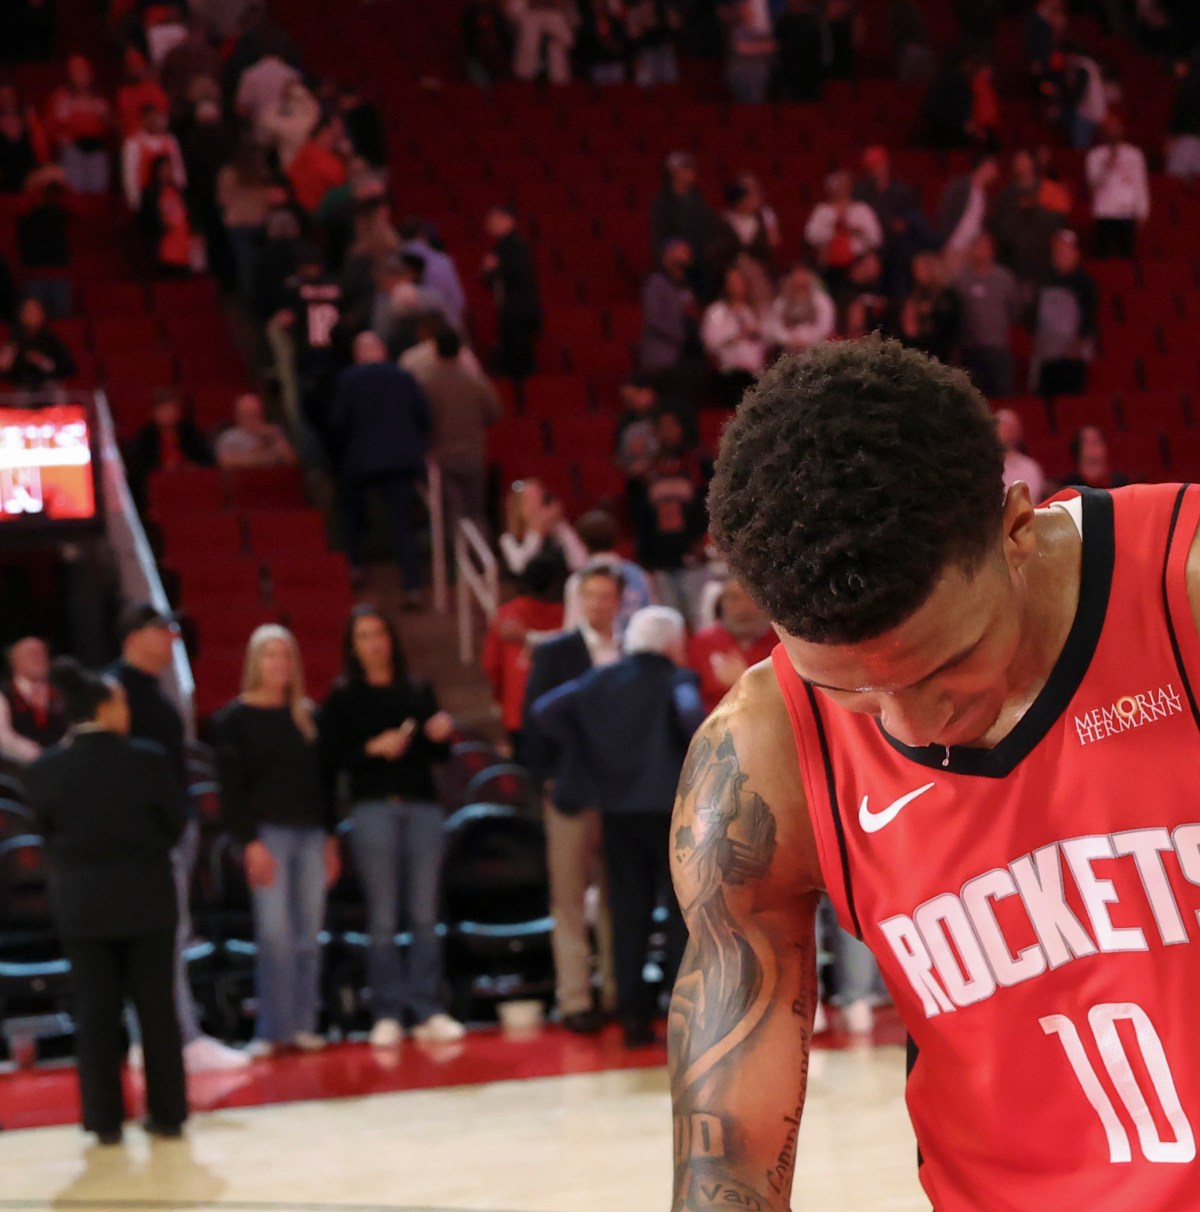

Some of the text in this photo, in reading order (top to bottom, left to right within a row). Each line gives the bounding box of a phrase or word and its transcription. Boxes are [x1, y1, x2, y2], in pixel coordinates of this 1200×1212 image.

[1075, 684, 1180, 732] MEMORIAL
[1077, 699, 1182, 745] HERMANN
[1038, 1002, 1197, 1163] 10
[702, 1184, 761, 1211] Van
